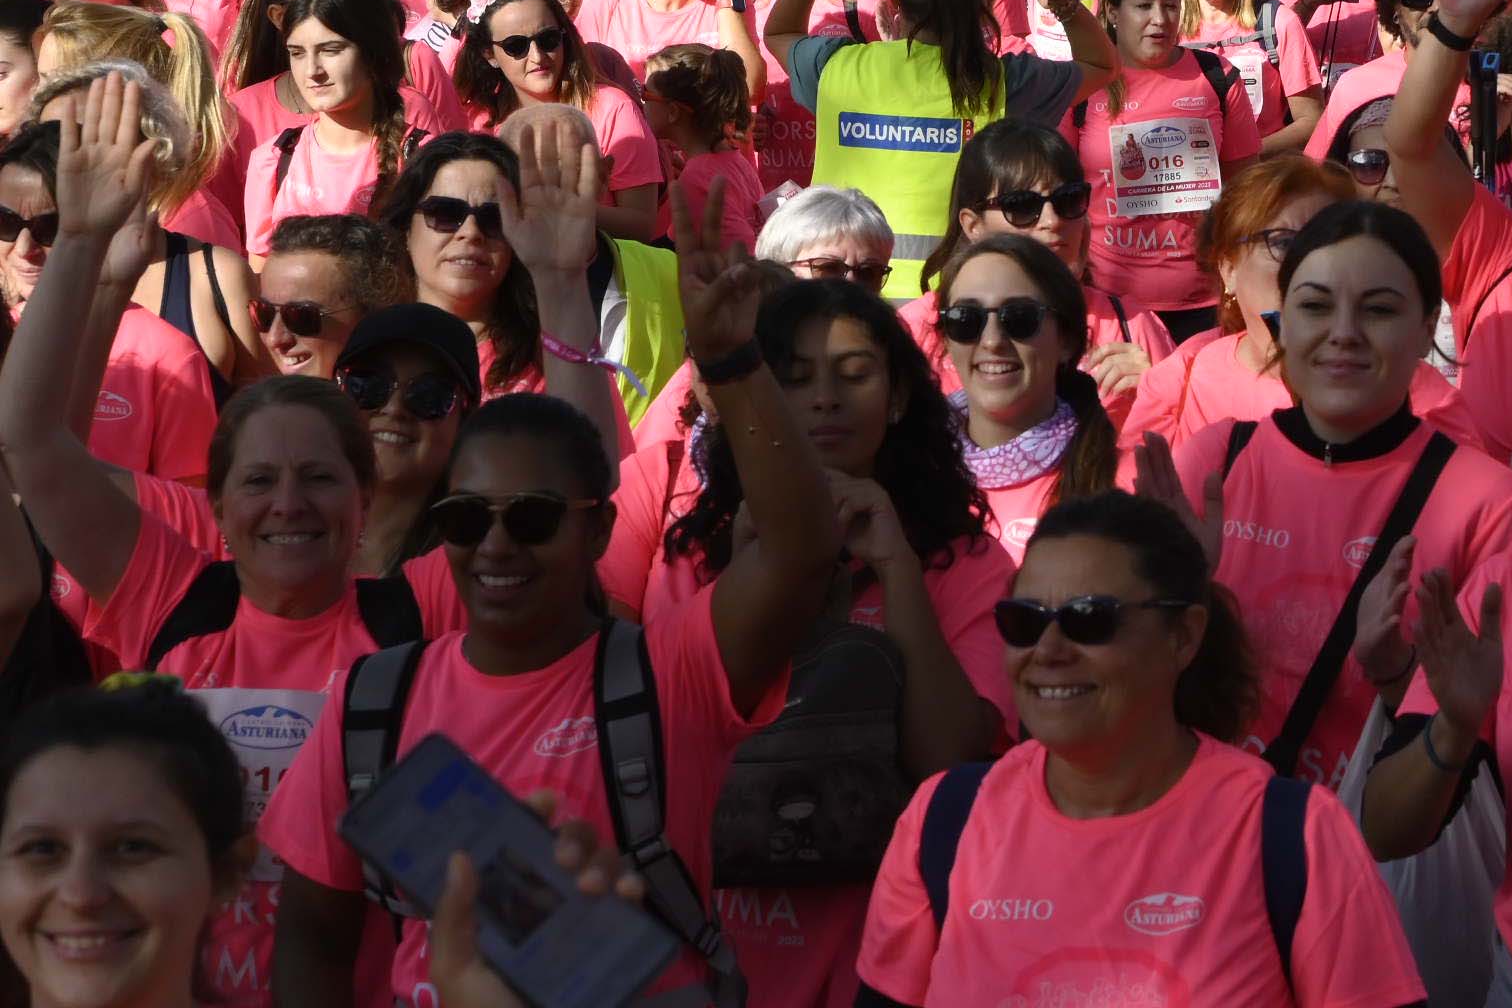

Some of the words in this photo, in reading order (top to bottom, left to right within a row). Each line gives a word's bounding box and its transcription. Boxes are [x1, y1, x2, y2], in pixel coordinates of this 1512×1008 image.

[840, 121, 958, 145] VOLUNTARIS
[1144, 134, 1184, 144] ASTURIANA
[1148, 155, 1184, 170] 016
[1153, 172, 1181, 182] 17885
[1175, 183, 1196, 191] MUJER
[1126, 199, 1158, 209] OYSHO
[1103, 224, 1178, 250] SUMA
[1223, 519, 1290, 549] OYSHO
[227, 719, 307, 740] ASTURIANA
[969, 898, 1053, 921] OYSHO
